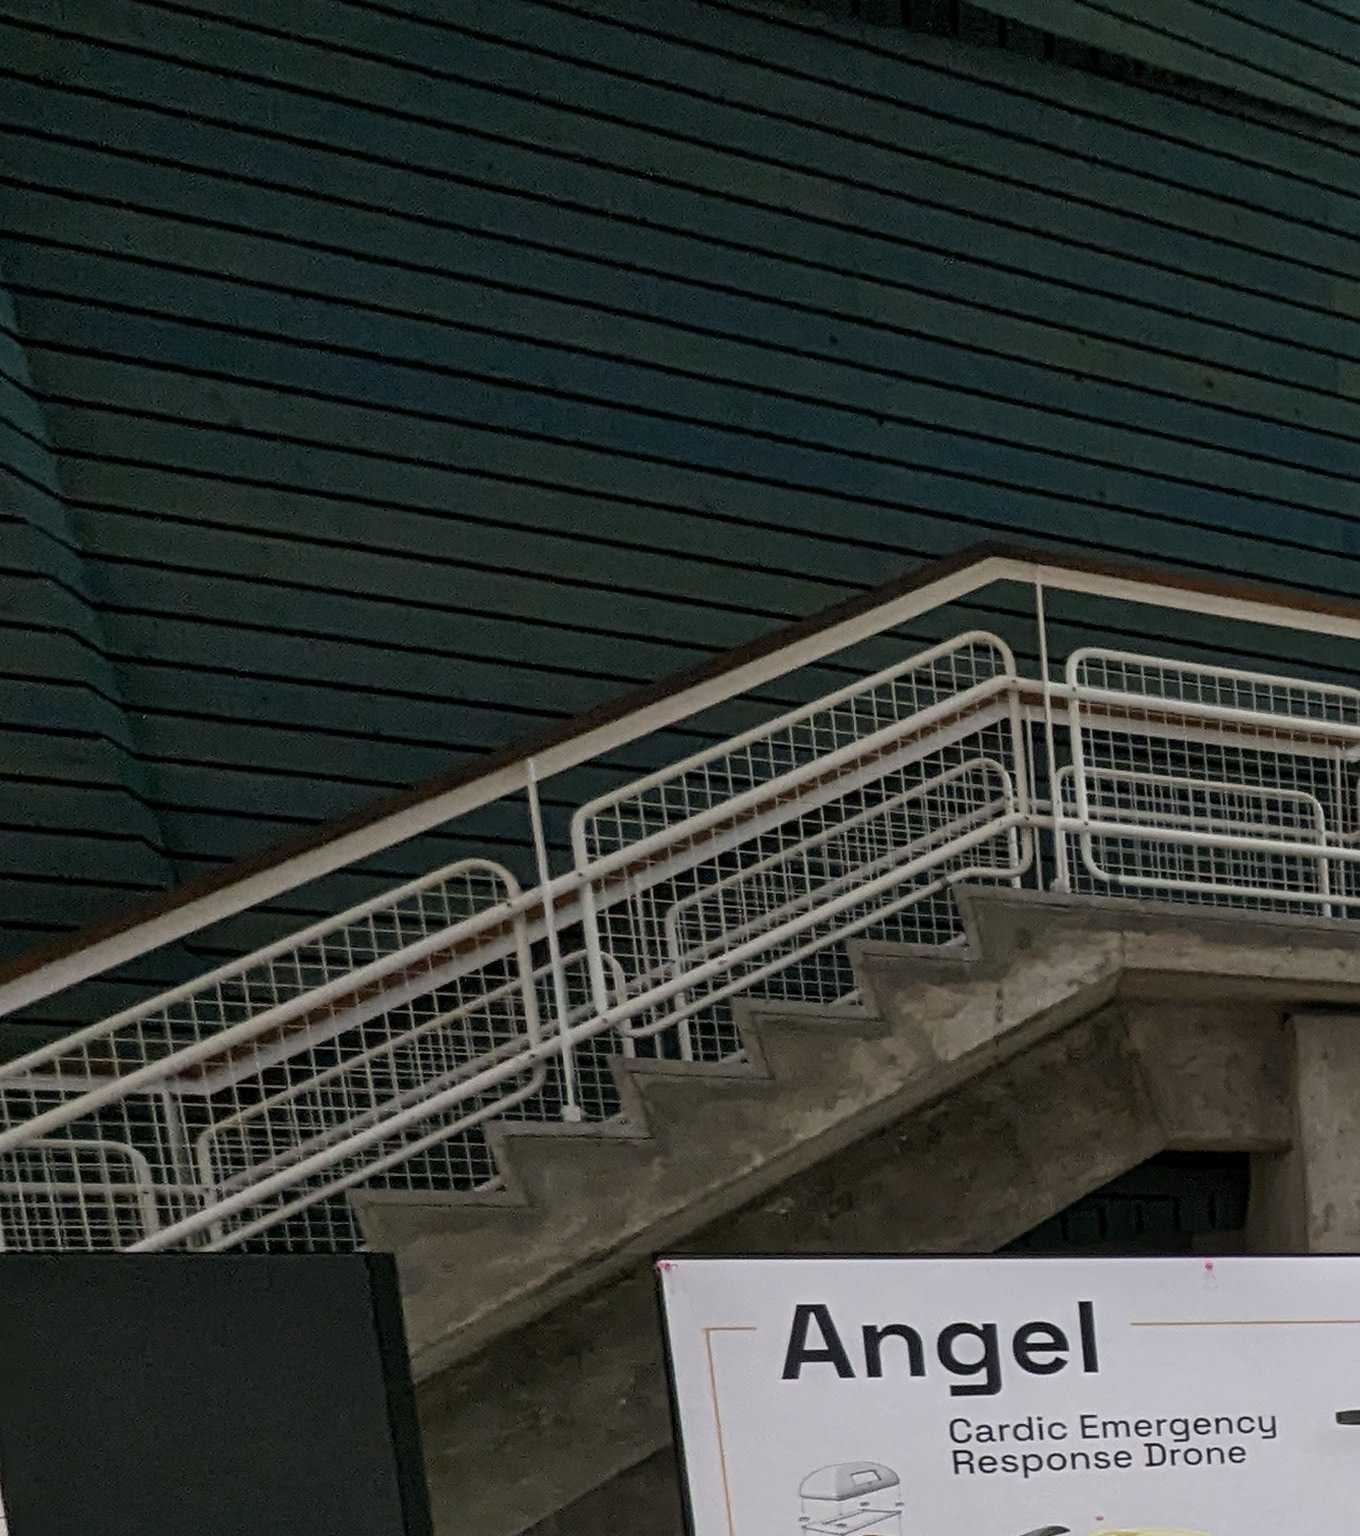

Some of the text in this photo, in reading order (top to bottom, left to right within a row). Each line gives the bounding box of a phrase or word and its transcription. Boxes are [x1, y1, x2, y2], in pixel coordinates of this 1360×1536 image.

[782, 1300, 1100, 1396] Angel
[948, 1412, 1278, 1445] Cardic Emergency
[952, 1443, 1247, 1479] Response Drone
